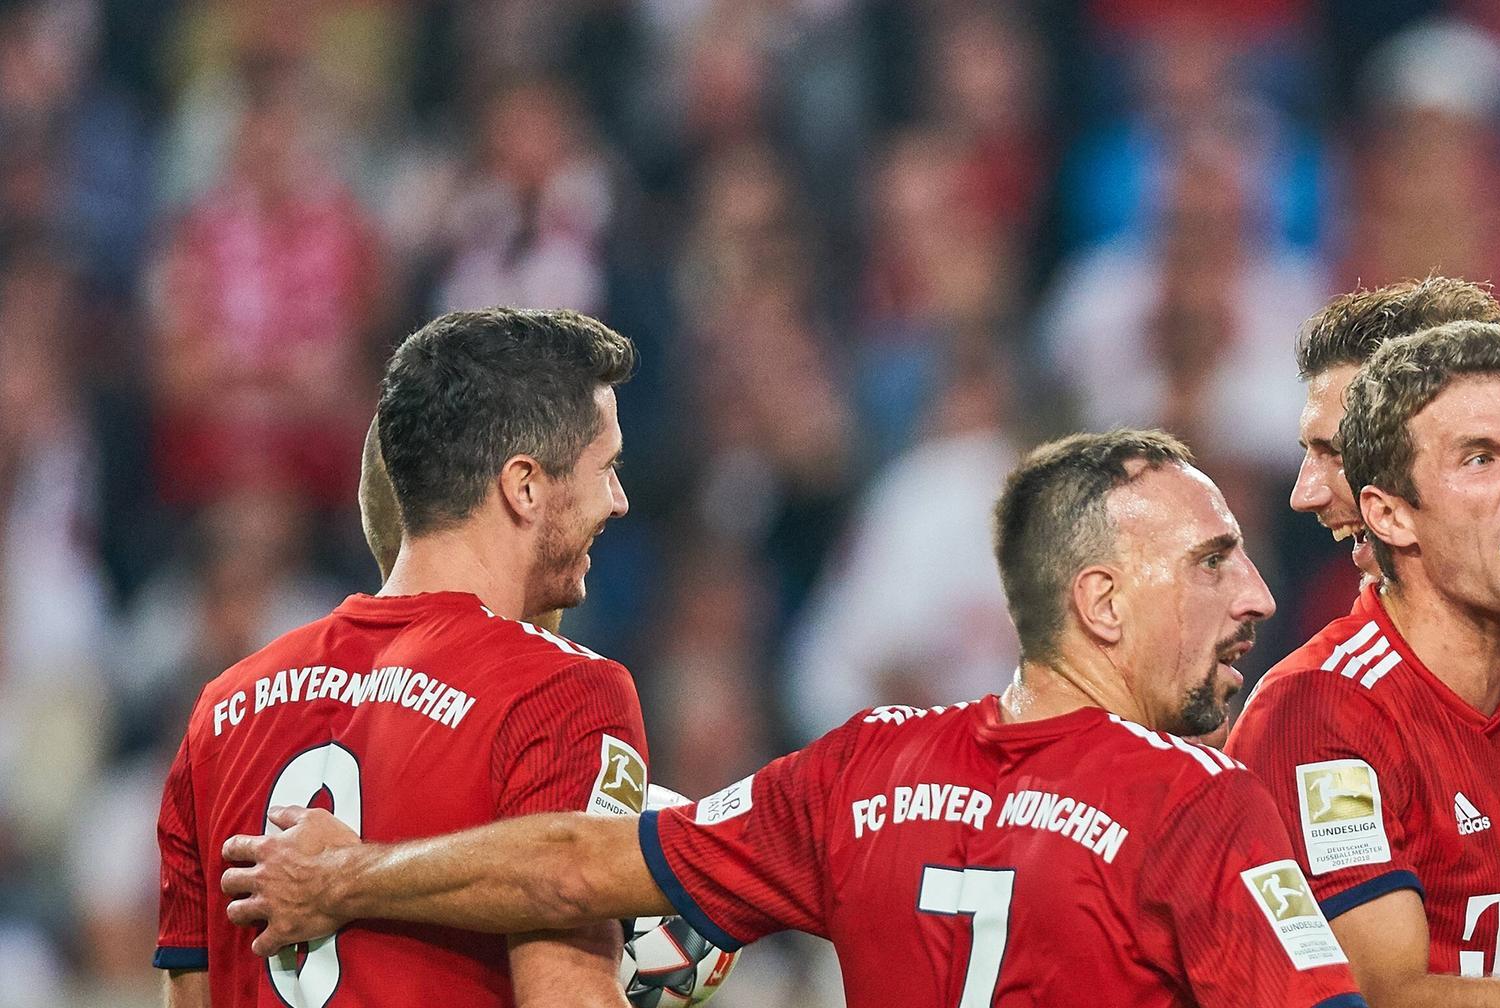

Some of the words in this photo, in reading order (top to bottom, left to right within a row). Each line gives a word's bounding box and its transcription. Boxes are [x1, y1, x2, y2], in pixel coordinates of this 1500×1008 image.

[213, 690, 246, 736] FC
[254, 666, 370, 714] BAYERN
[852, 794, 886, 839] FC
[1311, 822, 1377, 838] BUNDESLIGA
[1316, 846, 1383, 863] FUSSBALLMEISTER
[1327, 843, 1369, 854] DEUTSCHER
[1332, 855, 1370, 867] 2017/2018
